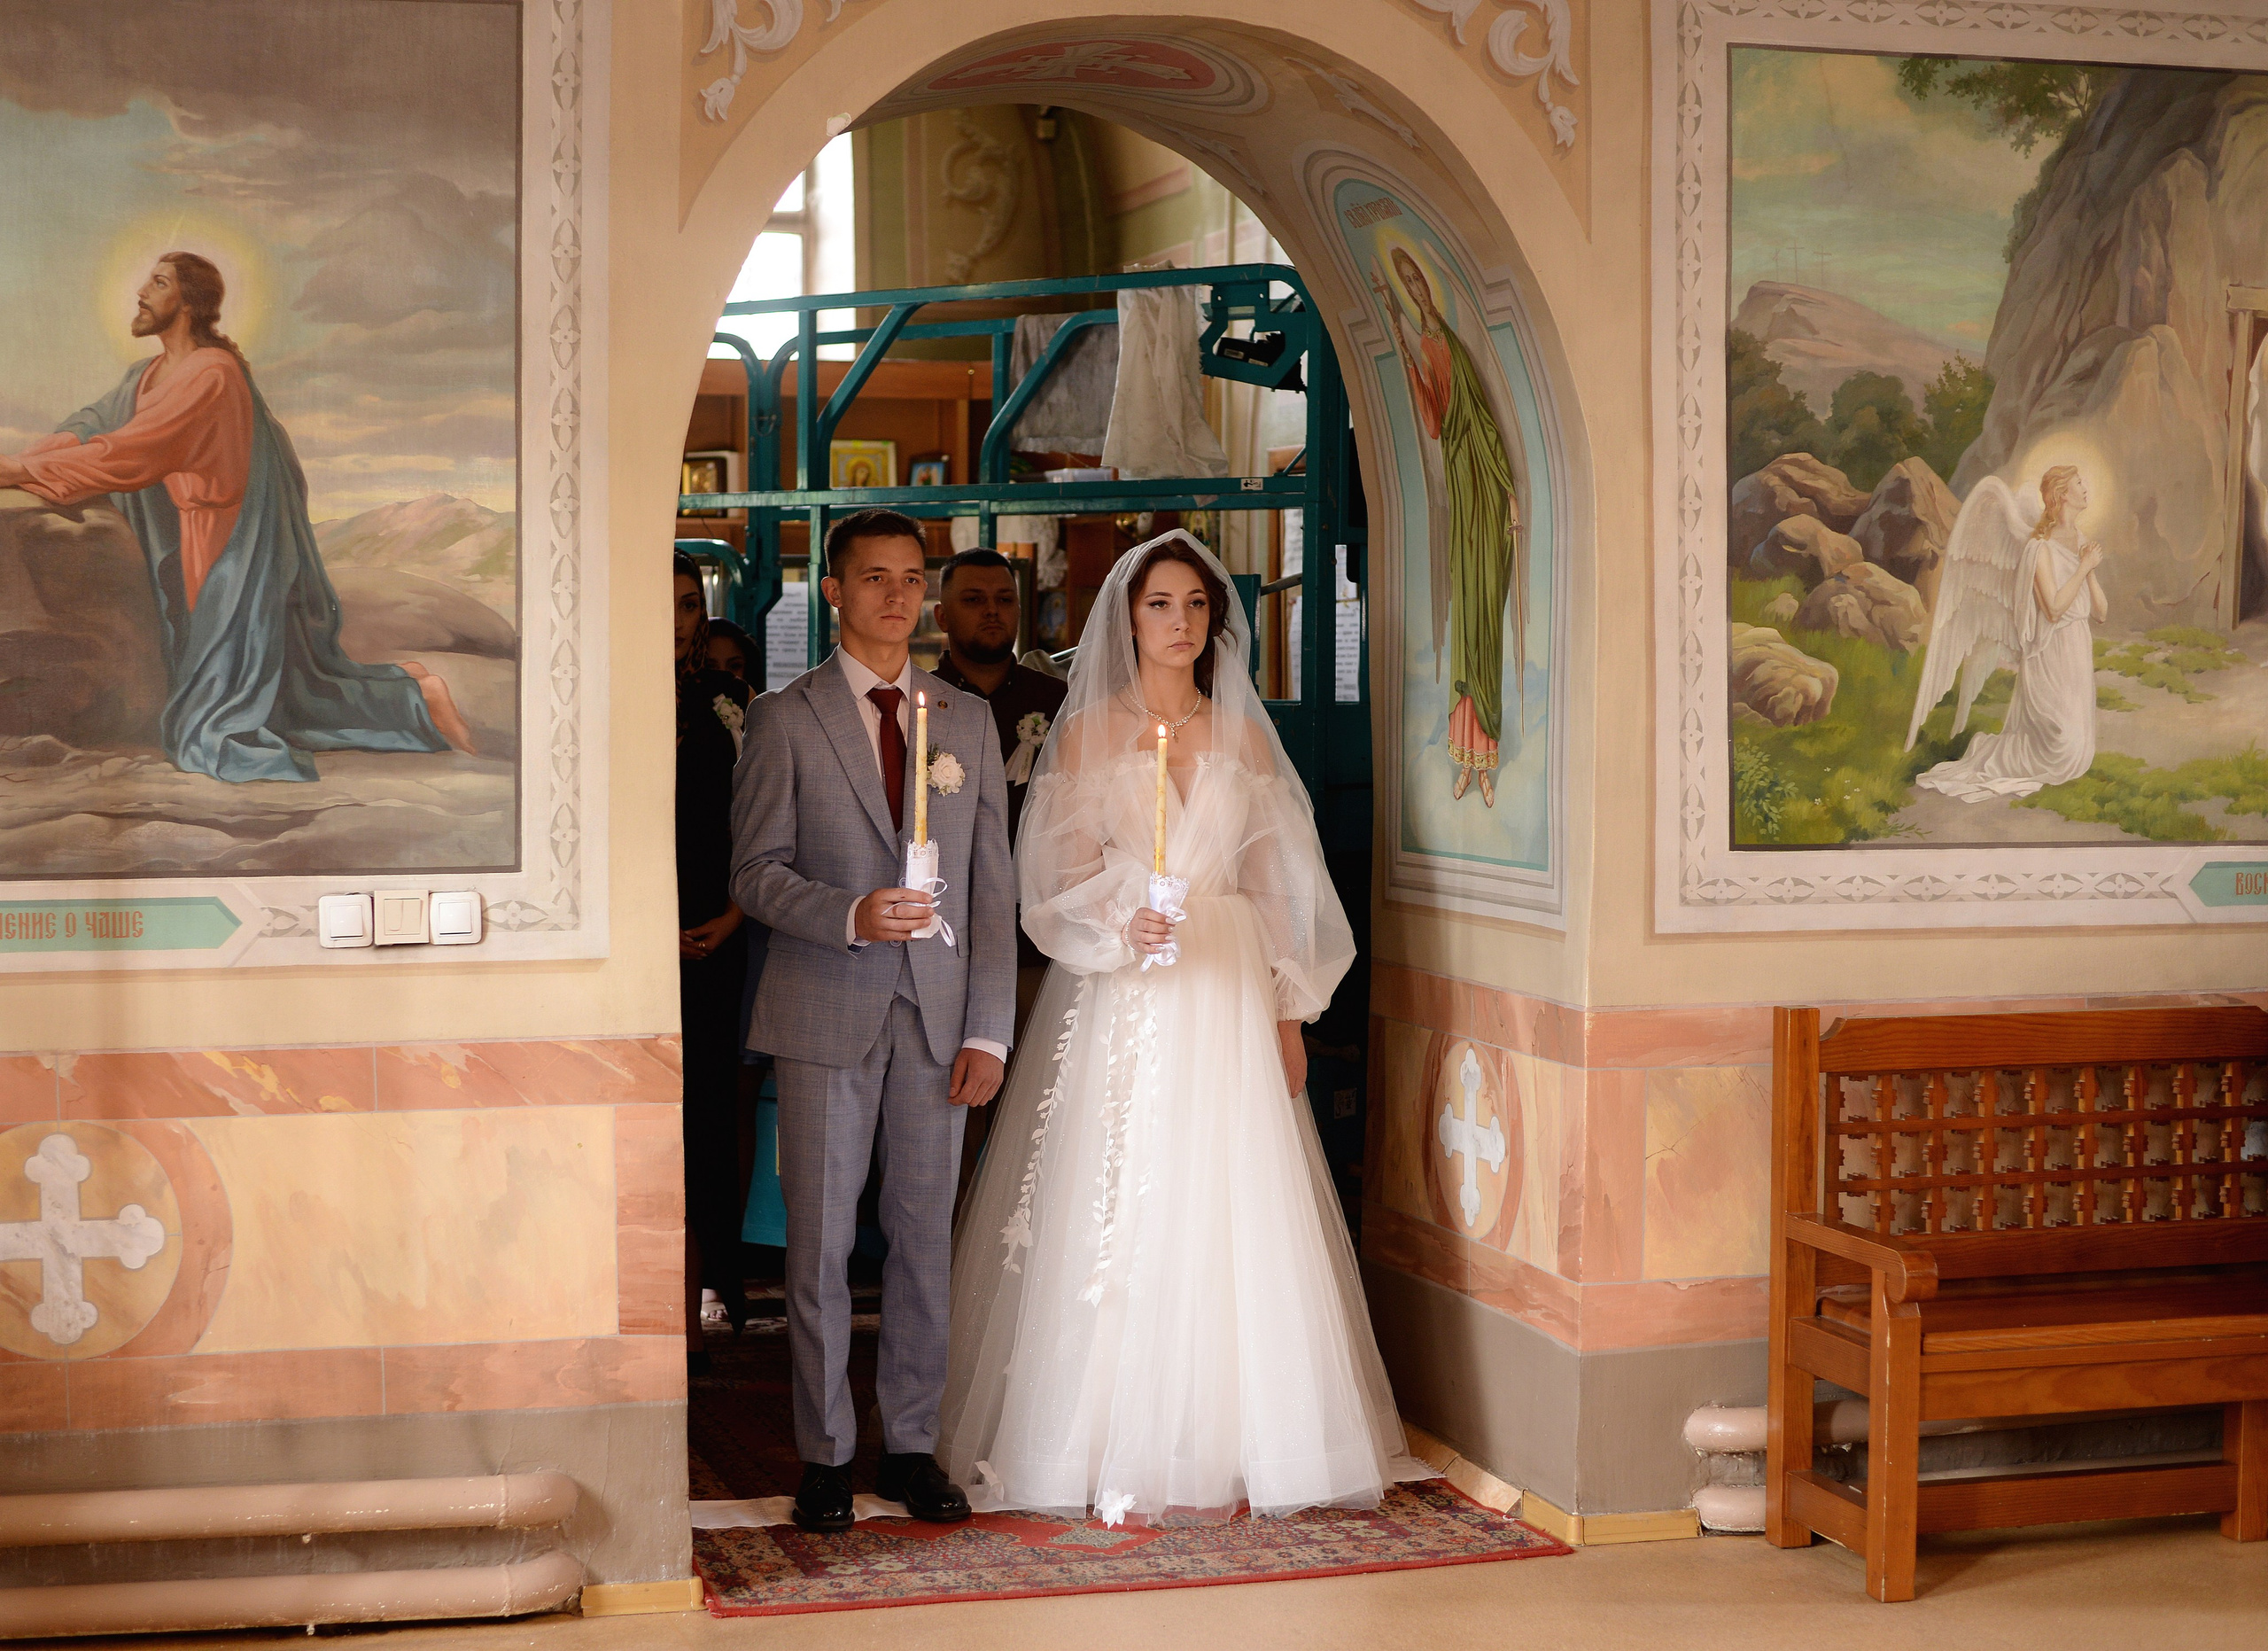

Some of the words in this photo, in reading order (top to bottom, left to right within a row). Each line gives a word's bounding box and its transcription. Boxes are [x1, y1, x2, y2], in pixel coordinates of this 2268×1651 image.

[0, 912, 57, 940] ЕНИЕ
[65, 912, 77, 938] О
[84, 910, 144, 939] ЧАШЕ
